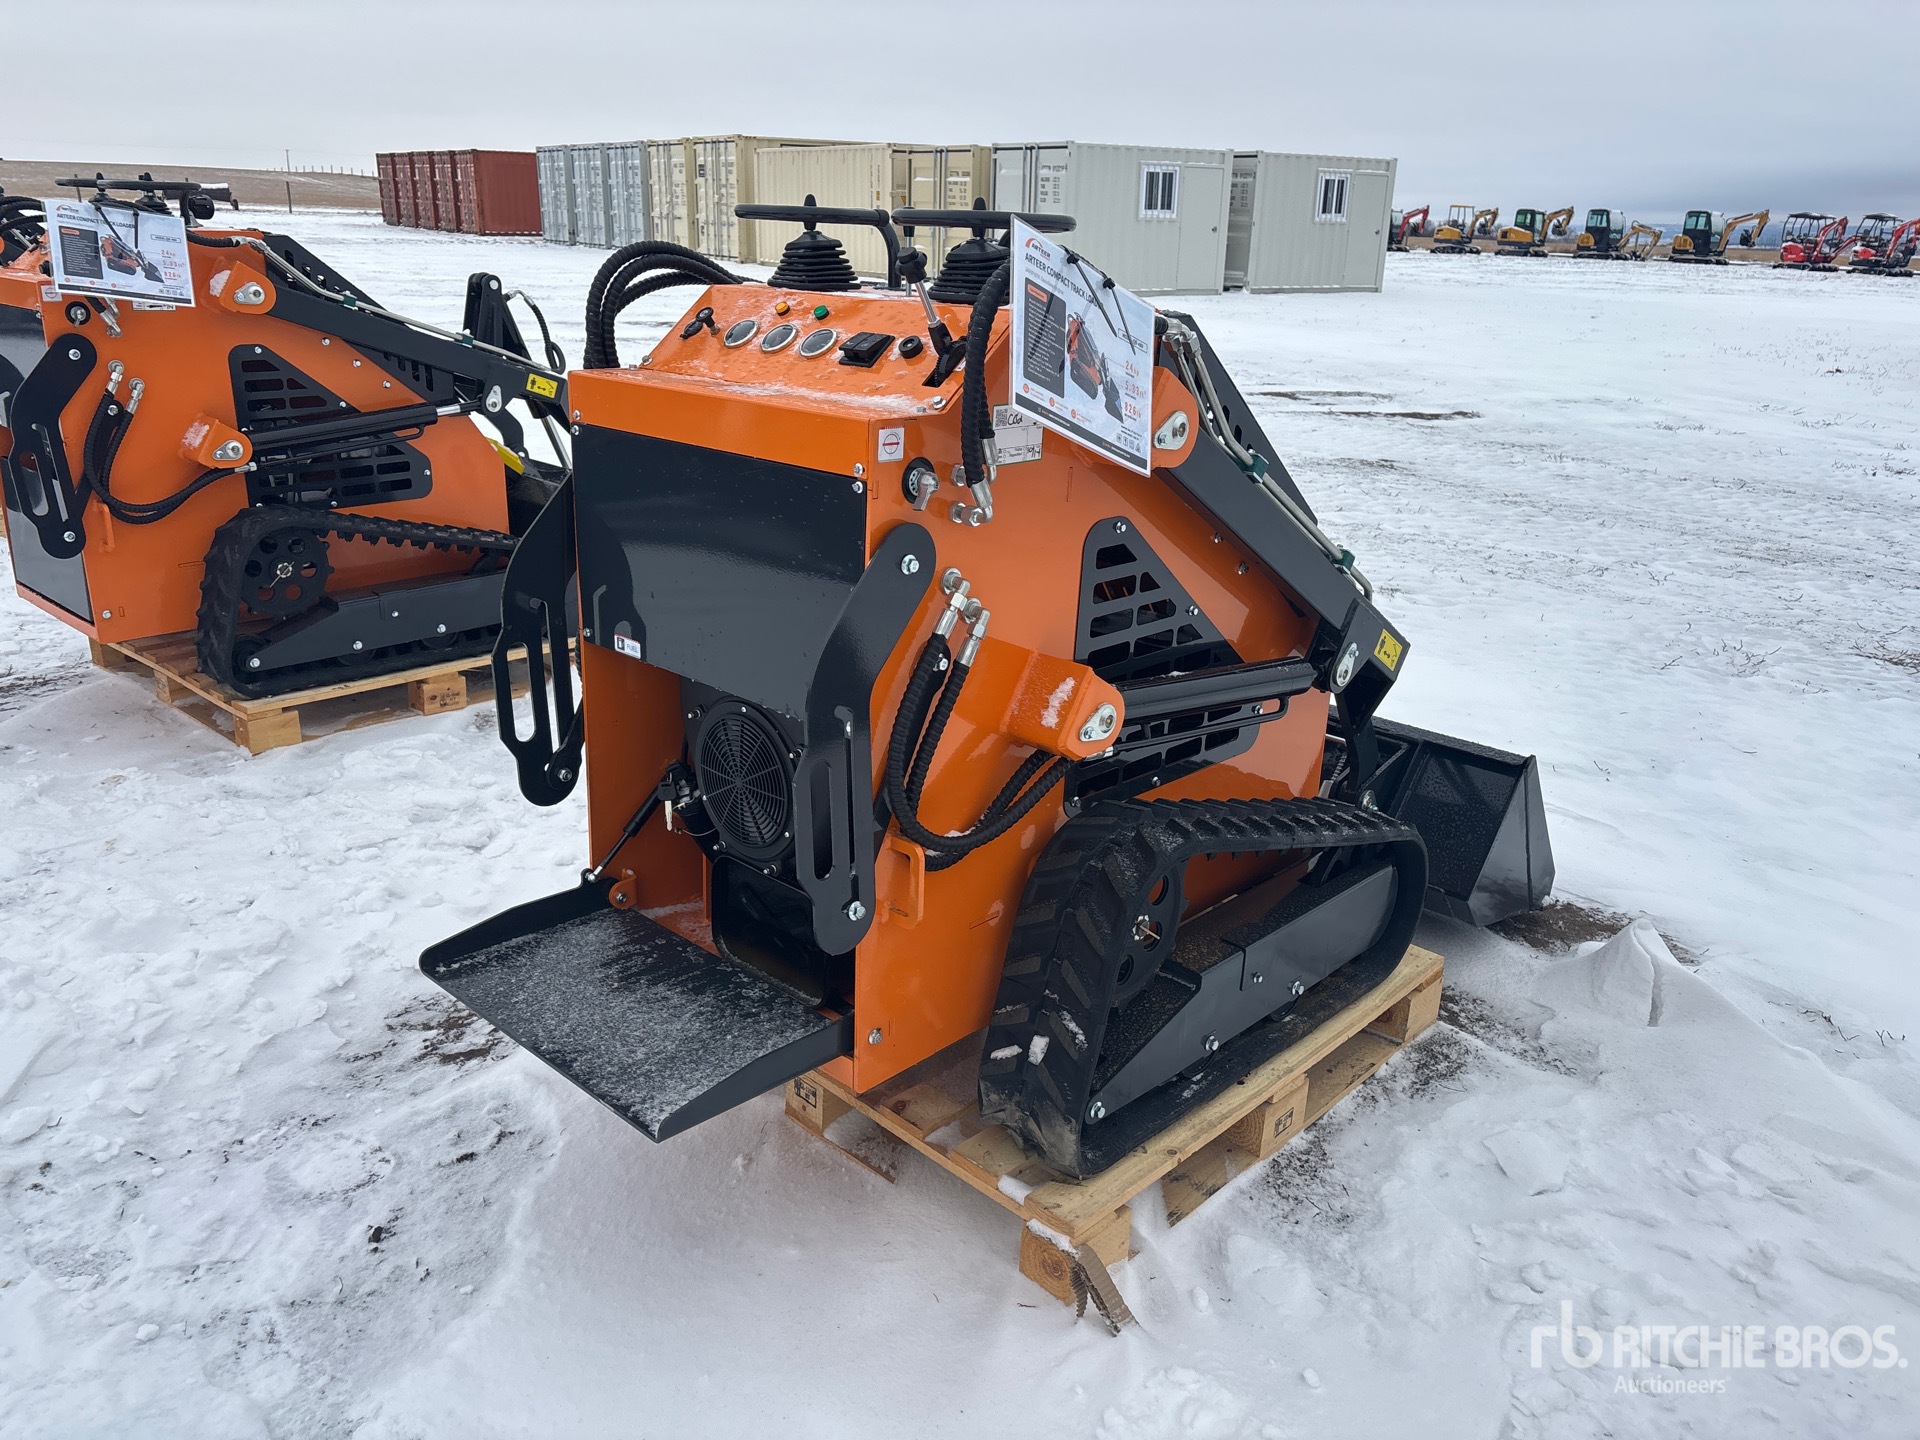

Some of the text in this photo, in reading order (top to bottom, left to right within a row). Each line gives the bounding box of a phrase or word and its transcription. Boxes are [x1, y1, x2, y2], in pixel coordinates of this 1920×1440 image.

[1031, 243, 1051, 258] ARTEER
[1025, 252, 1046, 272] ARTEER
[1046, 265, 1070, 289] COMPACT
[1070, 281, 1086, 300] TRACK
[627, 644, 638, 653] FUEL
